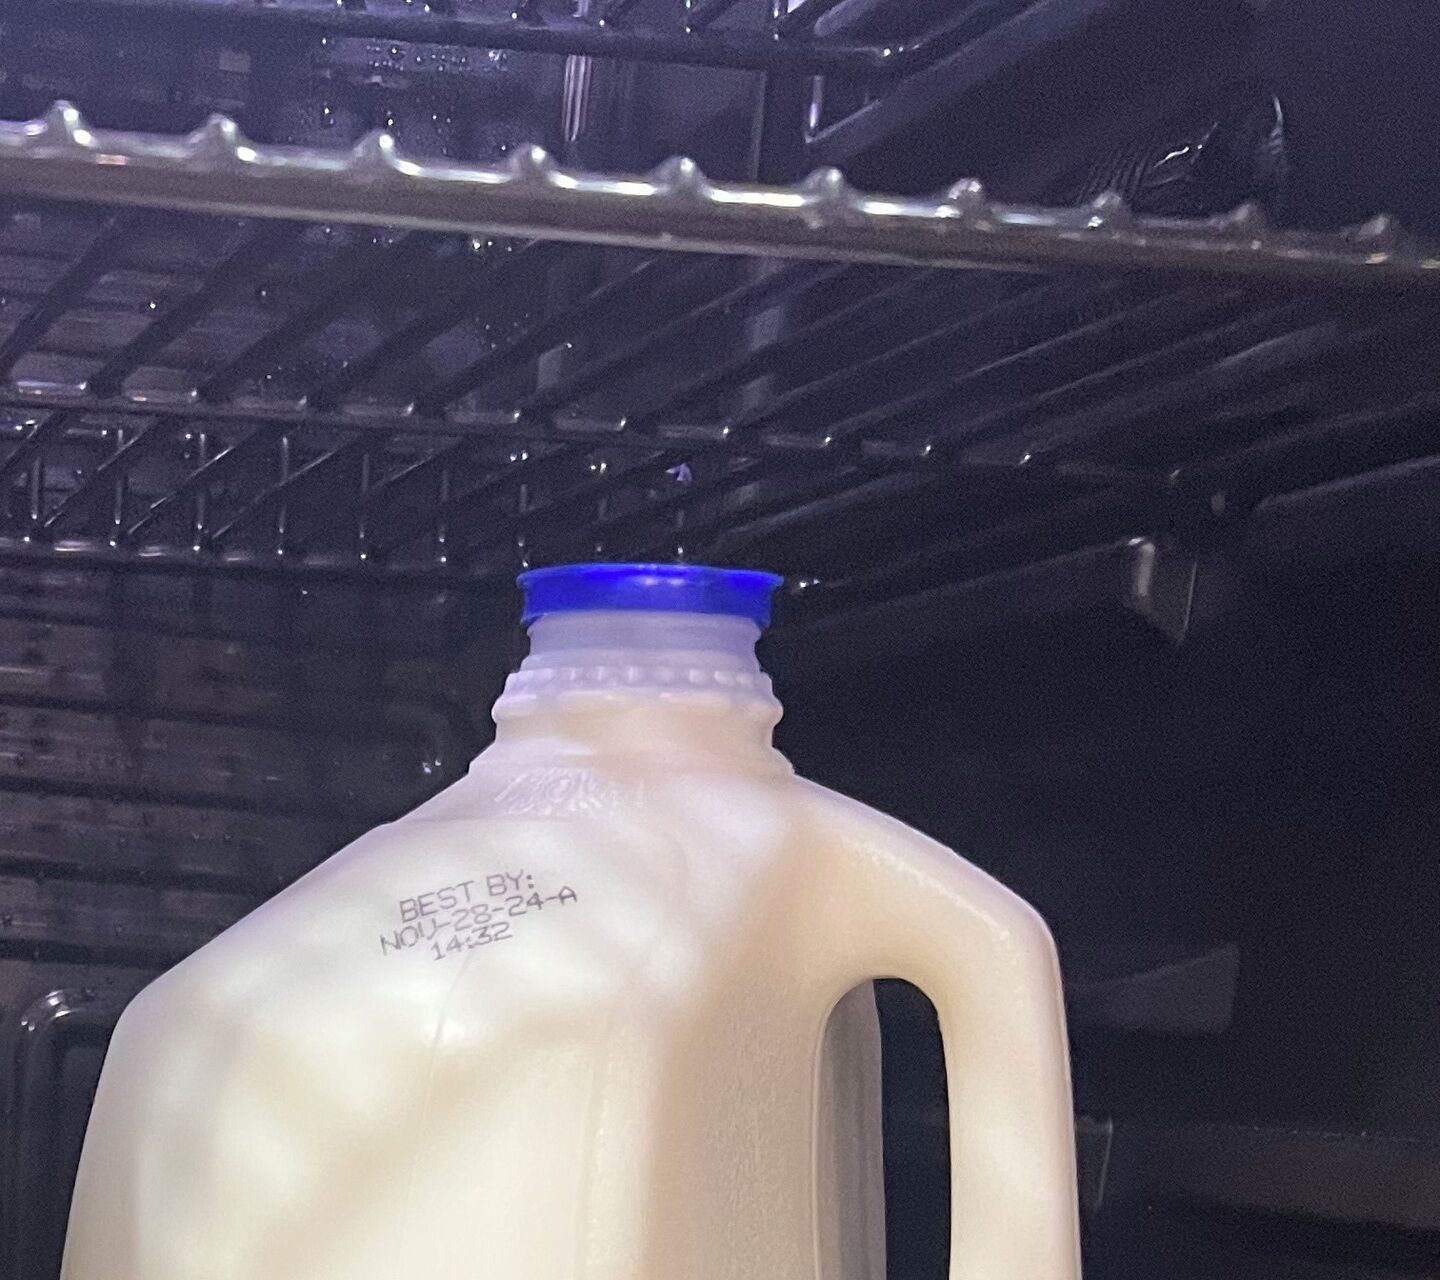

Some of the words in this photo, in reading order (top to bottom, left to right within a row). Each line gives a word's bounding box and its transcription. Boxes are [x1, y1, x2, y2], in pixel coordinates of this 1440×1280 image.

[399, 880, 475, 923] BEST
[486, 869, 534, 897] BY:
[433, 922, 512, 960] 14:32
